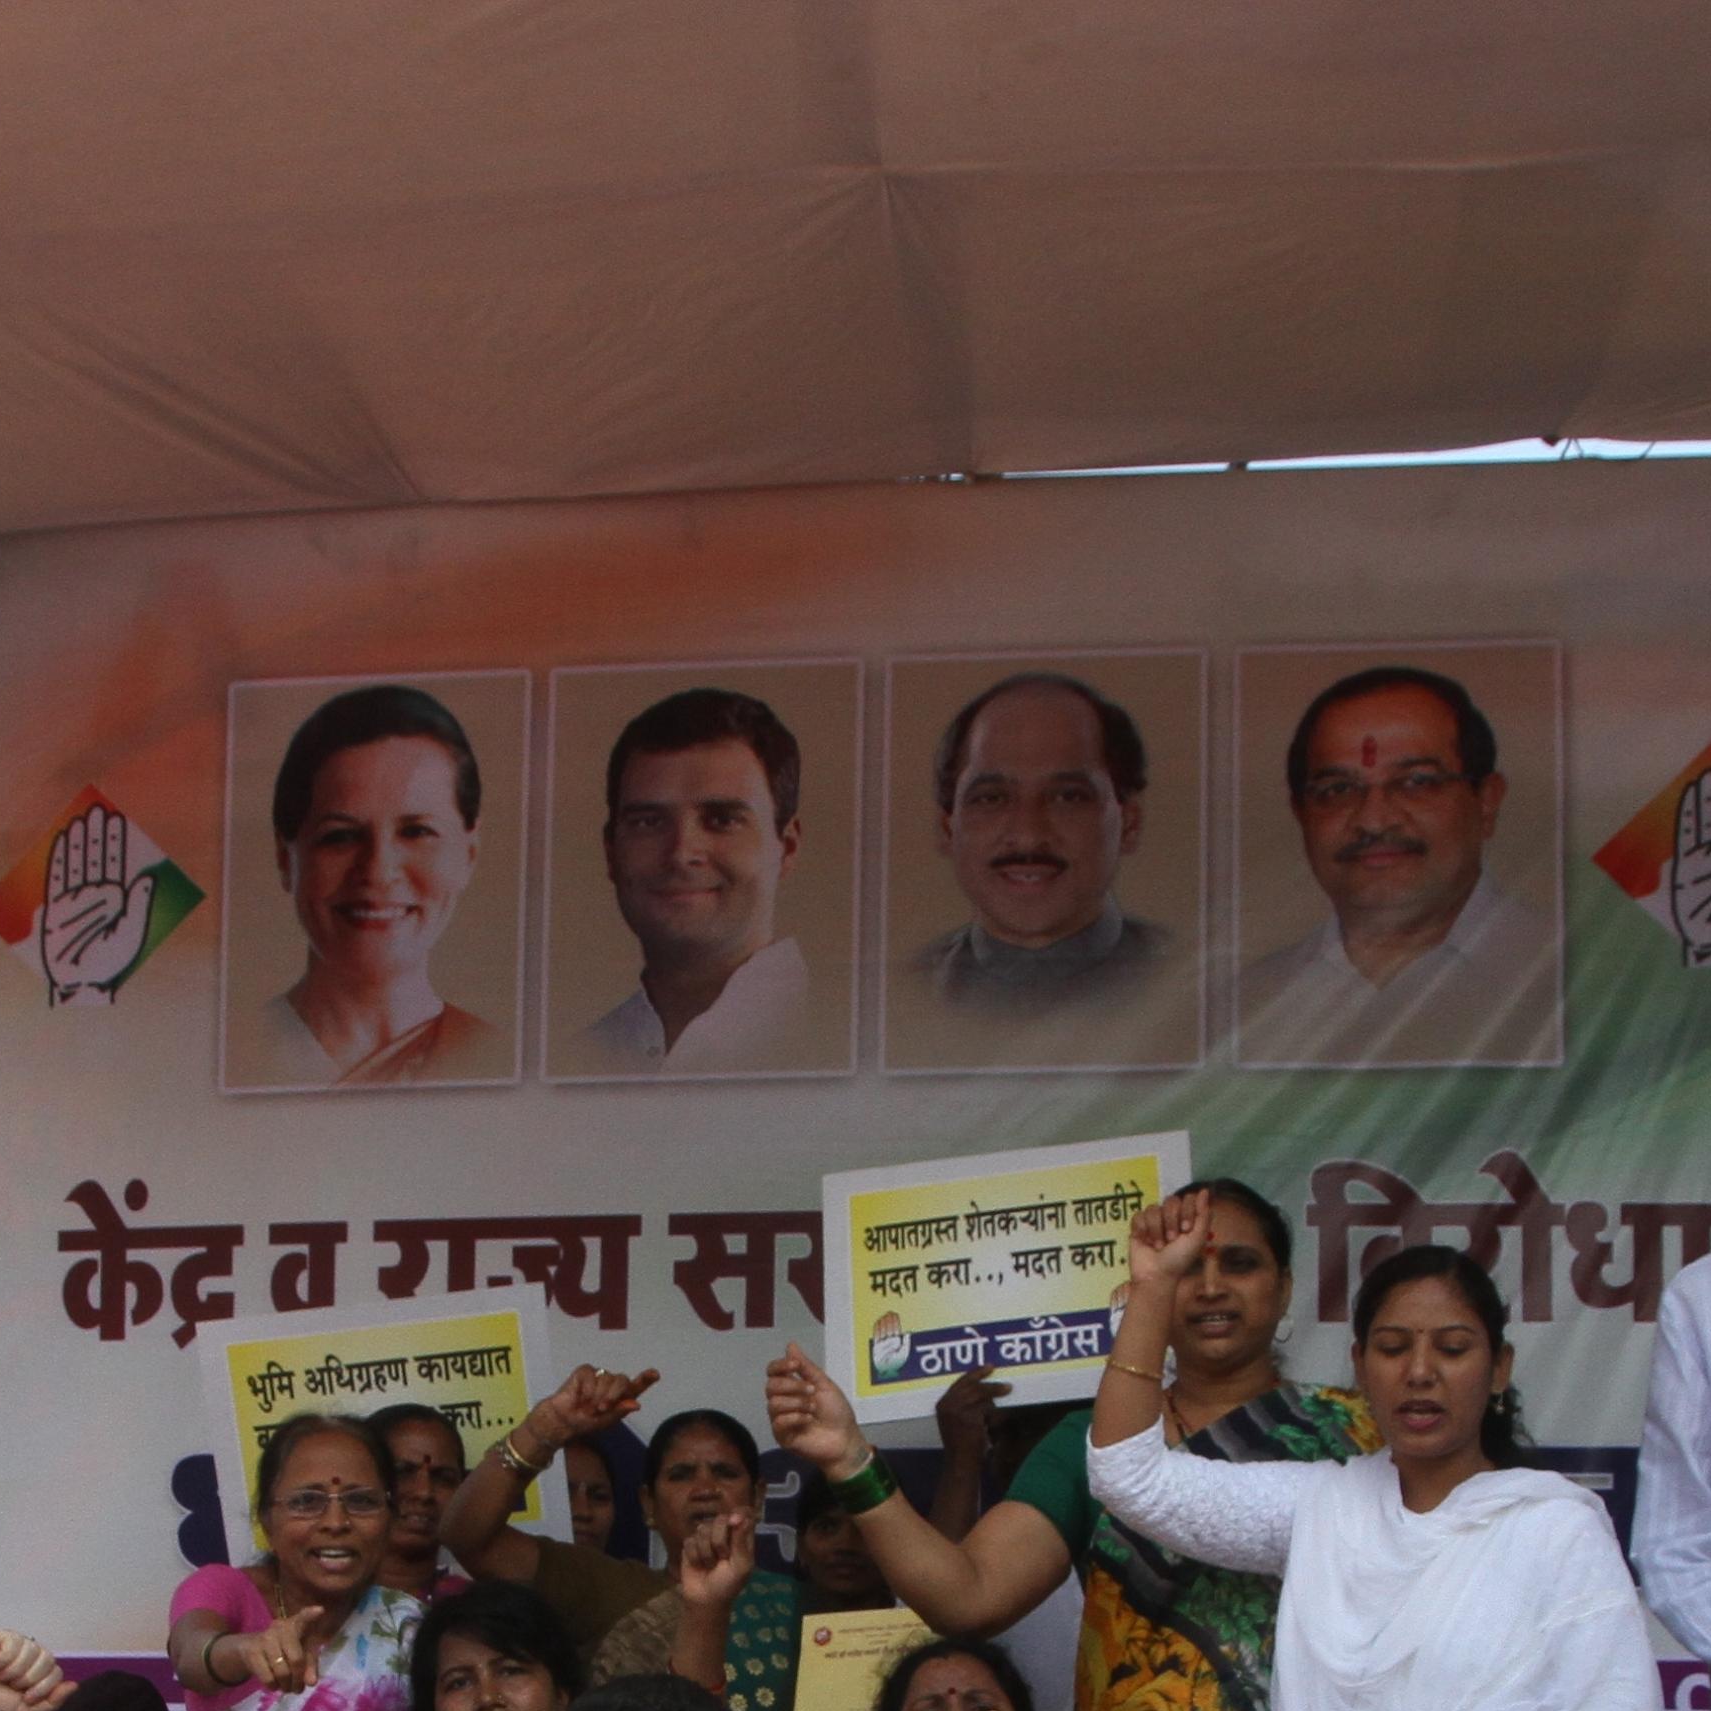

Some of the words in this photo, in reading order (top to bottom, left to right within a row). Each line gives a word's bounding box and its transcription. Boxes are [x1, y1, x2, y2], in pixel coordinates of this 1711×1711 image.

[268, 1221, 348, 1313] व
[869, 1264, 919, 1298] मदत
[1011, 1245, 1062, 1280] मदत
[304, 1354, 409, 1395] अधिग्रहण
[916, 1327, 989, 1375] ठाणे
